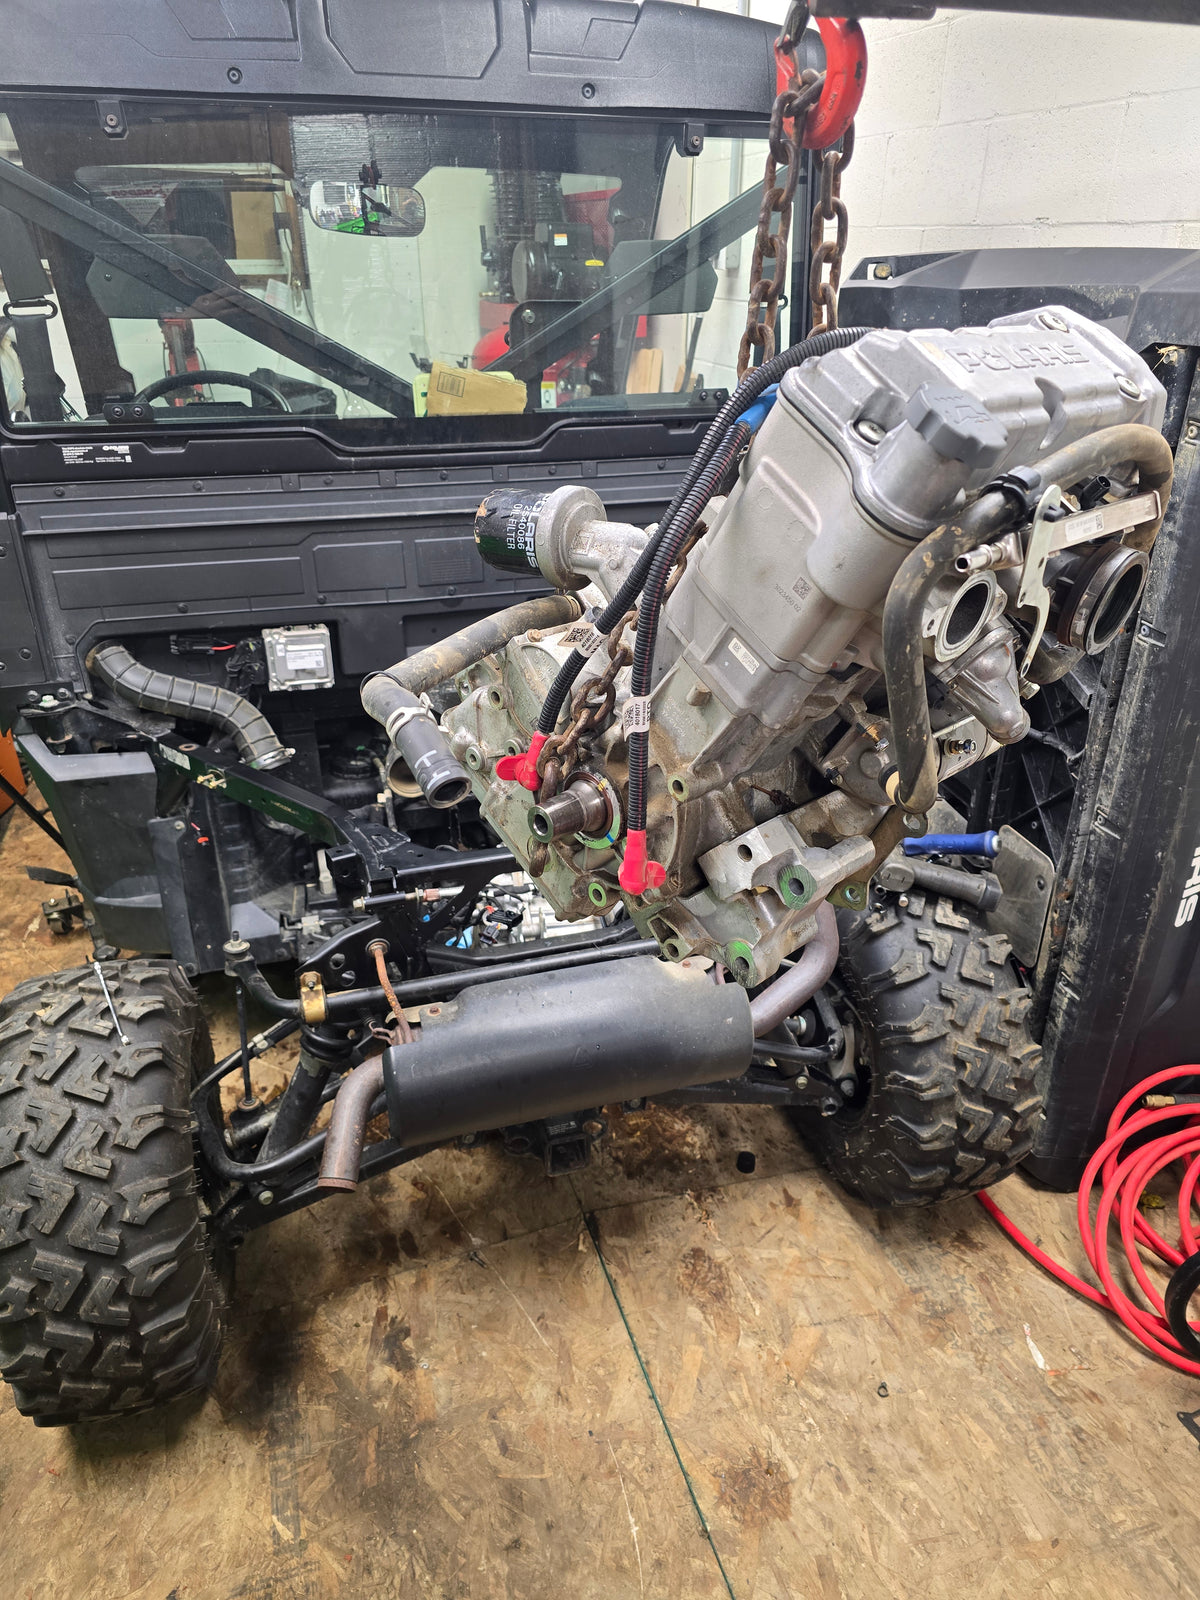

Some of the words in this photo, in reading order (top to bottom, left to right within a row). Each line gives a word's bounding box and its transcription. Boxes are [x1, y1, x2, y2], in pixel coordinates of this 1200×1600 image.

[944, 343, 1090, 373] POLARIS
[510, 503, 523, 517] OIL
[506, 518, 517, 550] FILTER
[517, 505, 533, 550] 2540086
[1174, 846, 1200, 928] RIS
